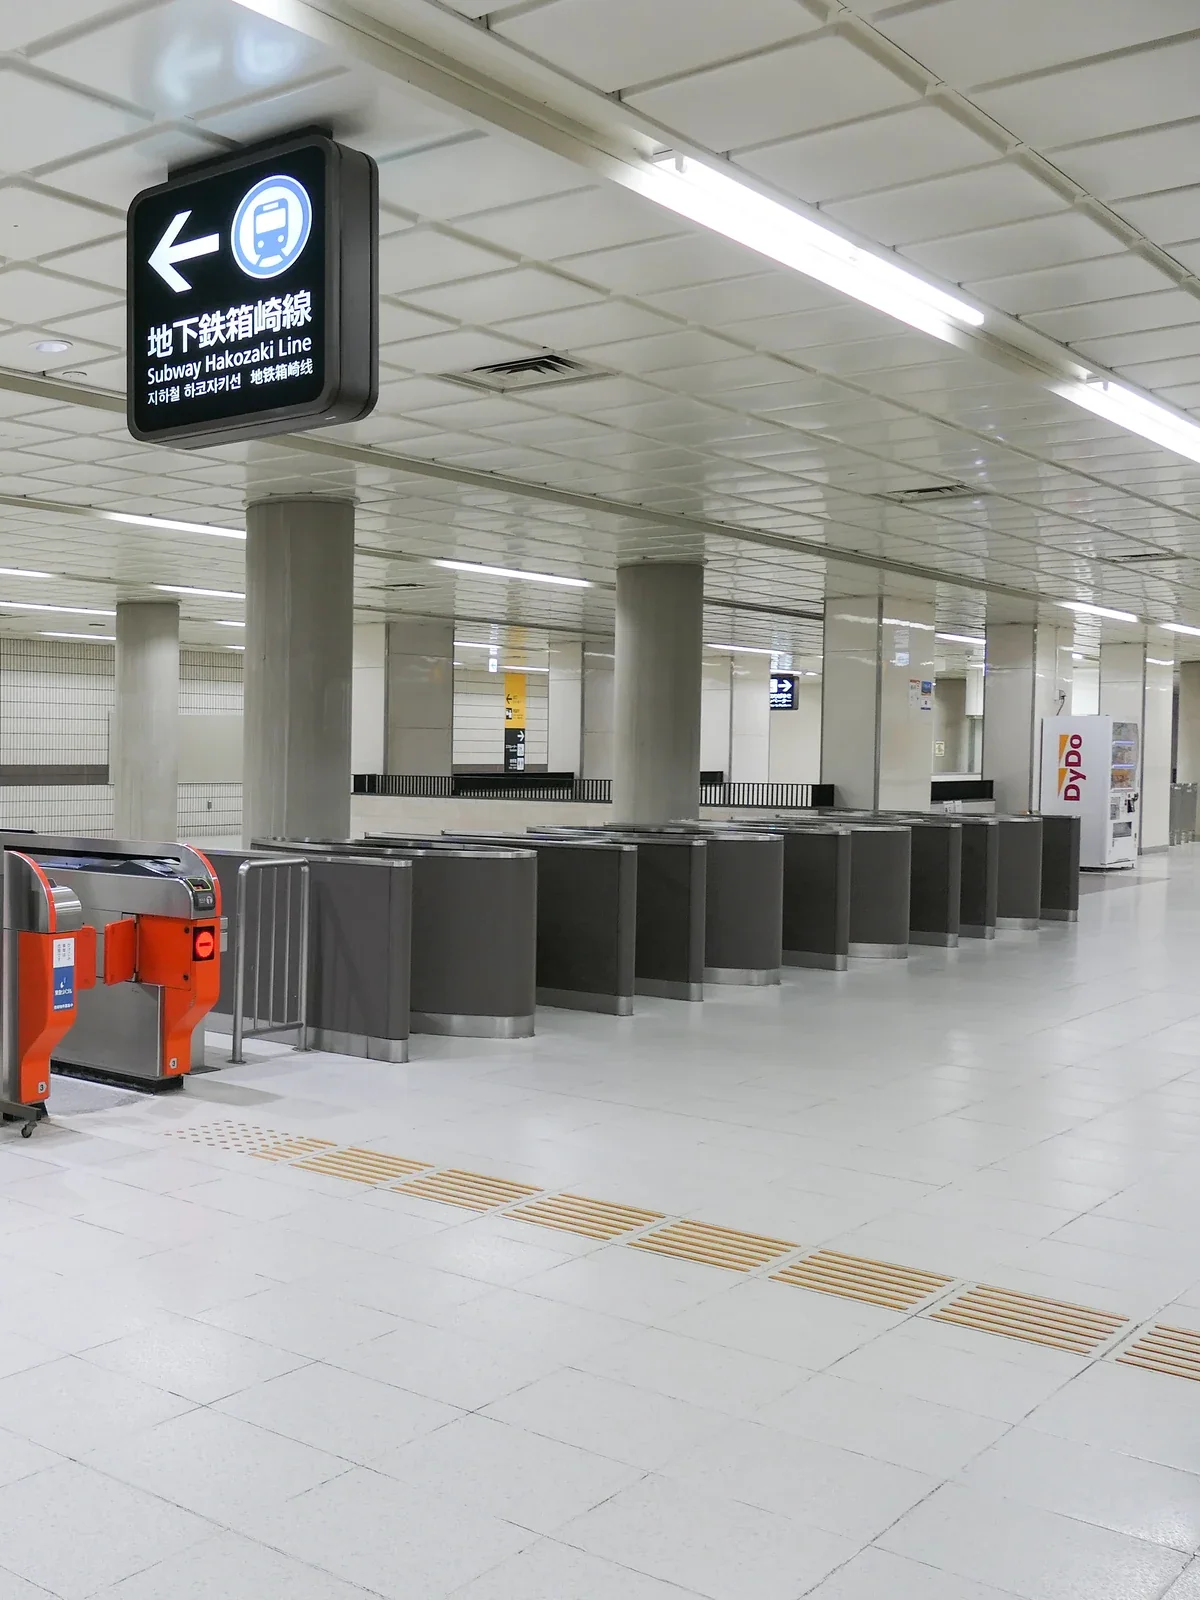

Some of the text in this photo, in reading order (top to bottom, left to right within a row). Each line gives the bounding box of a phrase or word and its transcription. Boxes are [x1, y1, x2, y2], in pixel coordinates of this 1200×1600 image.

[148, 290, 312, 358] 地下鉄箱崎線
[148, 335, 312, 385] Subway Hakozaki Line
[250, 358, 313, 385] 地铁箱崎线
[147, 373, 242, 406] 지하철 하코자키선
[1064, 734, 1086, 801] DyDo
